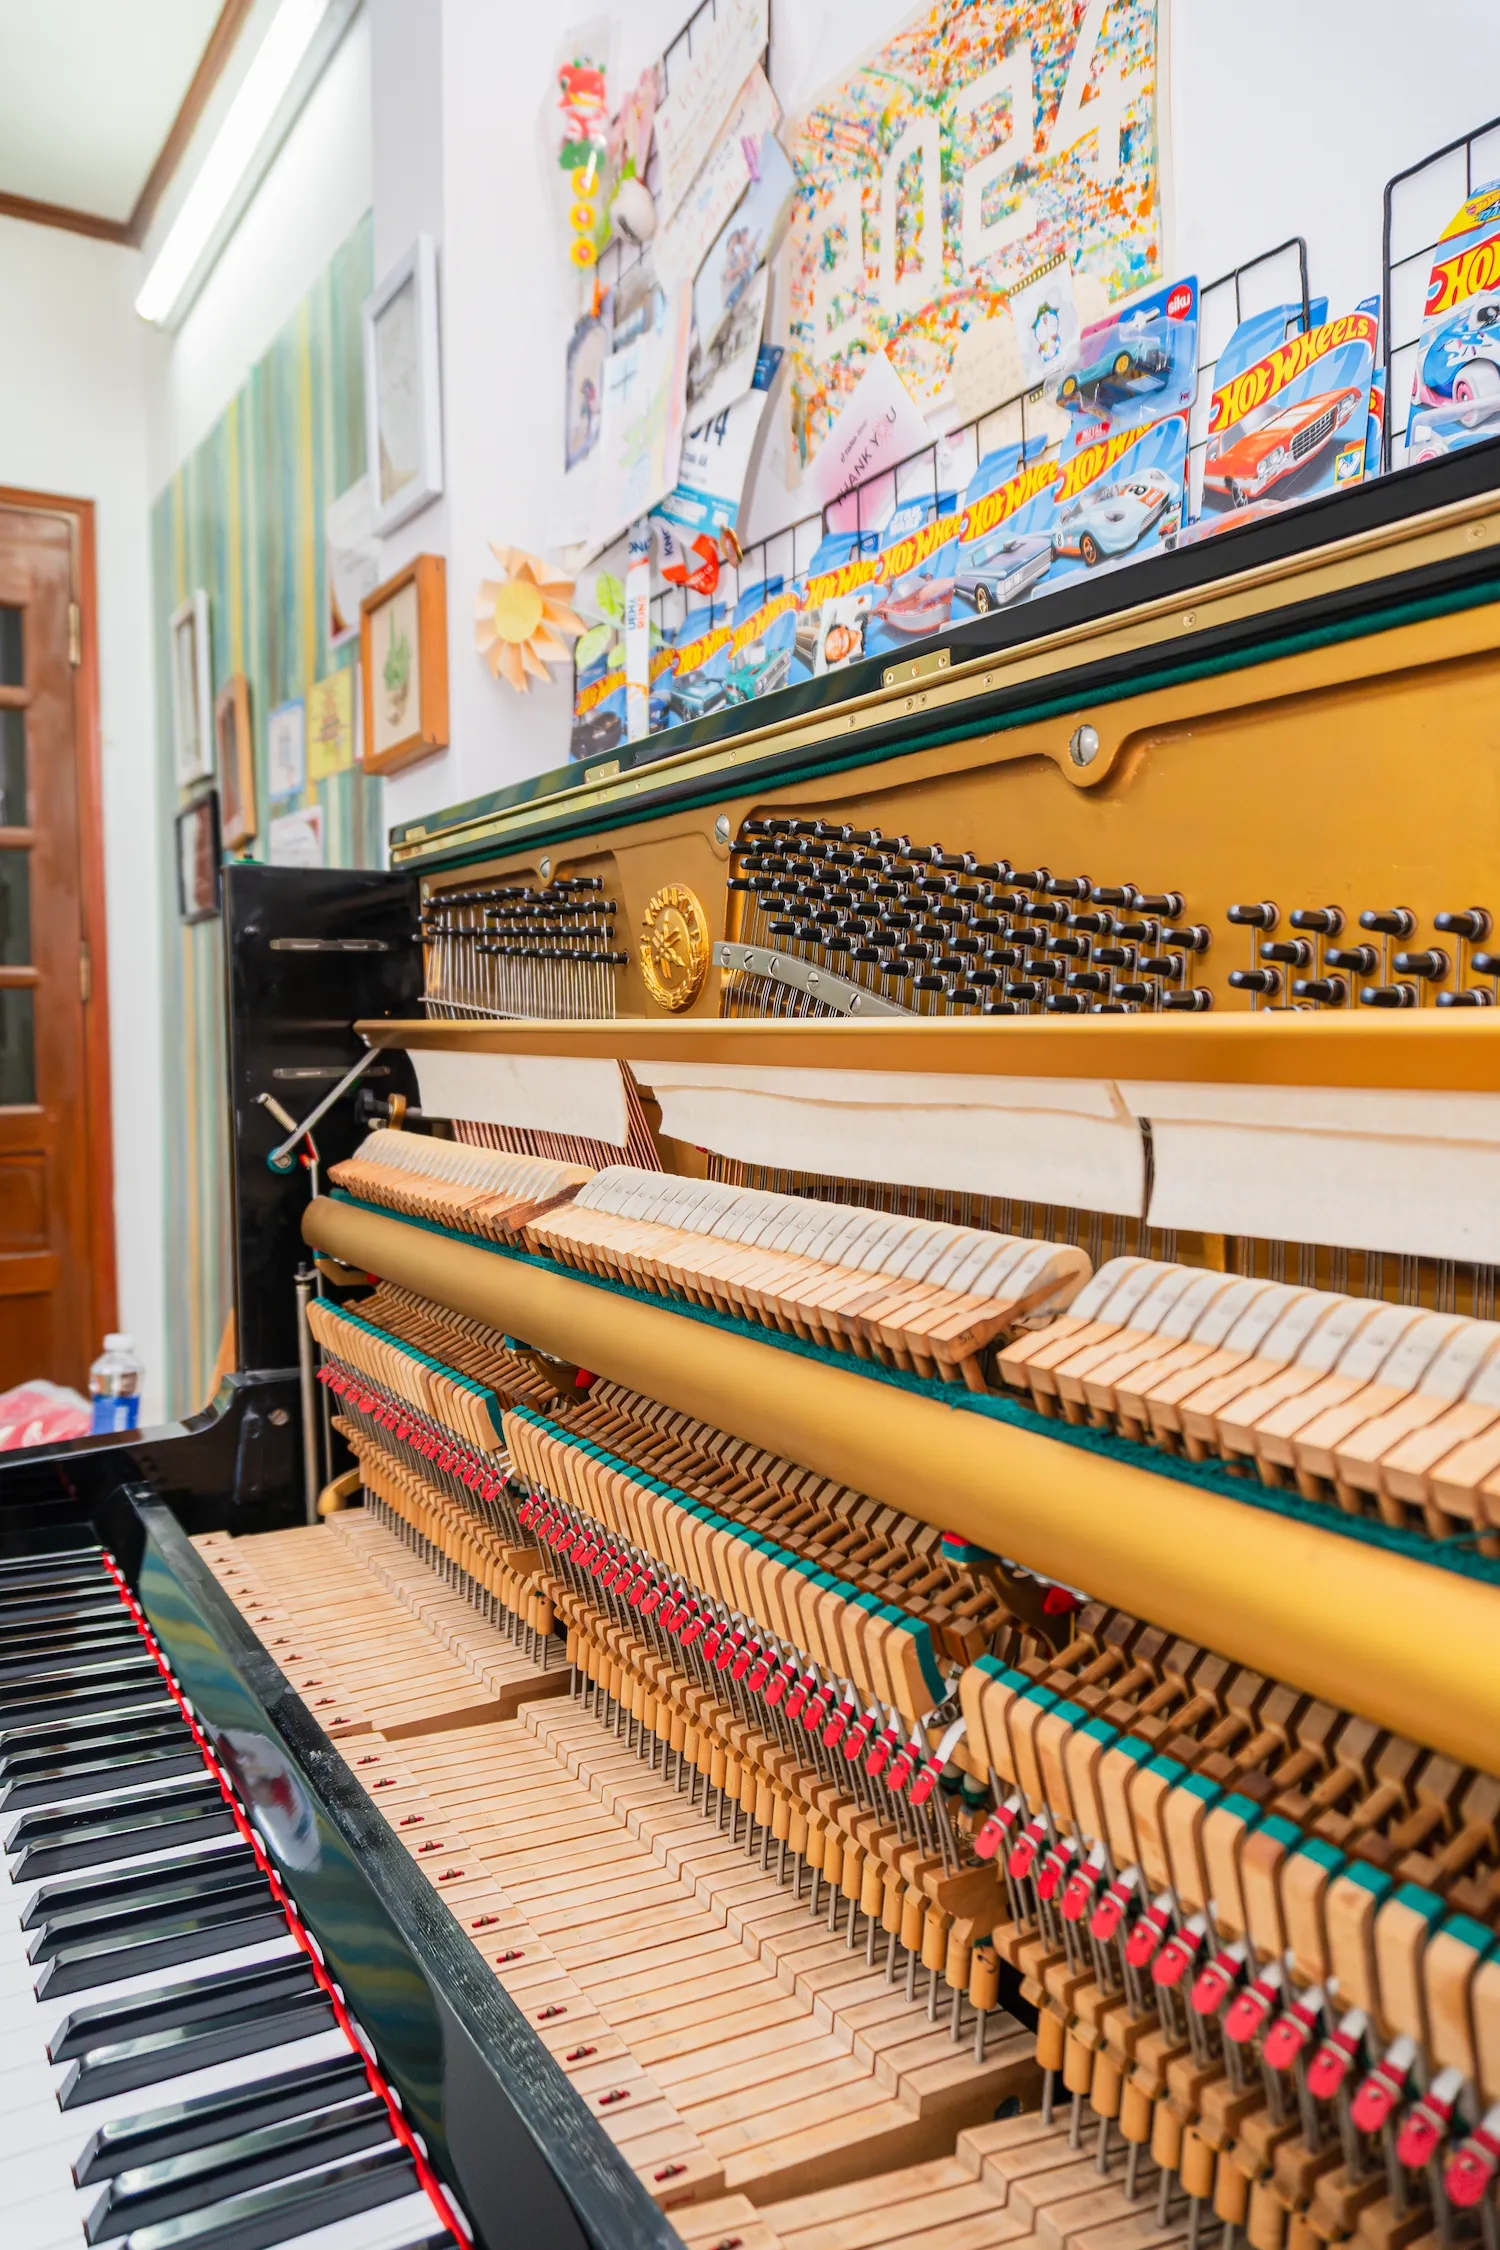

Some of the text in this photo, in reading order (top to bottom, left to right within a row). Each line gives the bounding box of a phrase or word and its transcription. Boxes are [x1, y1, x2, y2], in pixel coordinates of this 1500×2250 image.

[1167, 293, 1190, 314] siku
[1432, 241, 1500, 312] HO
[1214, 317, 1369, 431] HOT WHEELS
[963, 488, 1007, 542] HOT
[1003, 459, 1059, 515] WHEE
[1059, 443, 1106, 501] HOT
[879, 540, 916, 582] HOT
[914, 514, 962, 564] WHEE
[804, 559, 877, 611] HOT WHEE
